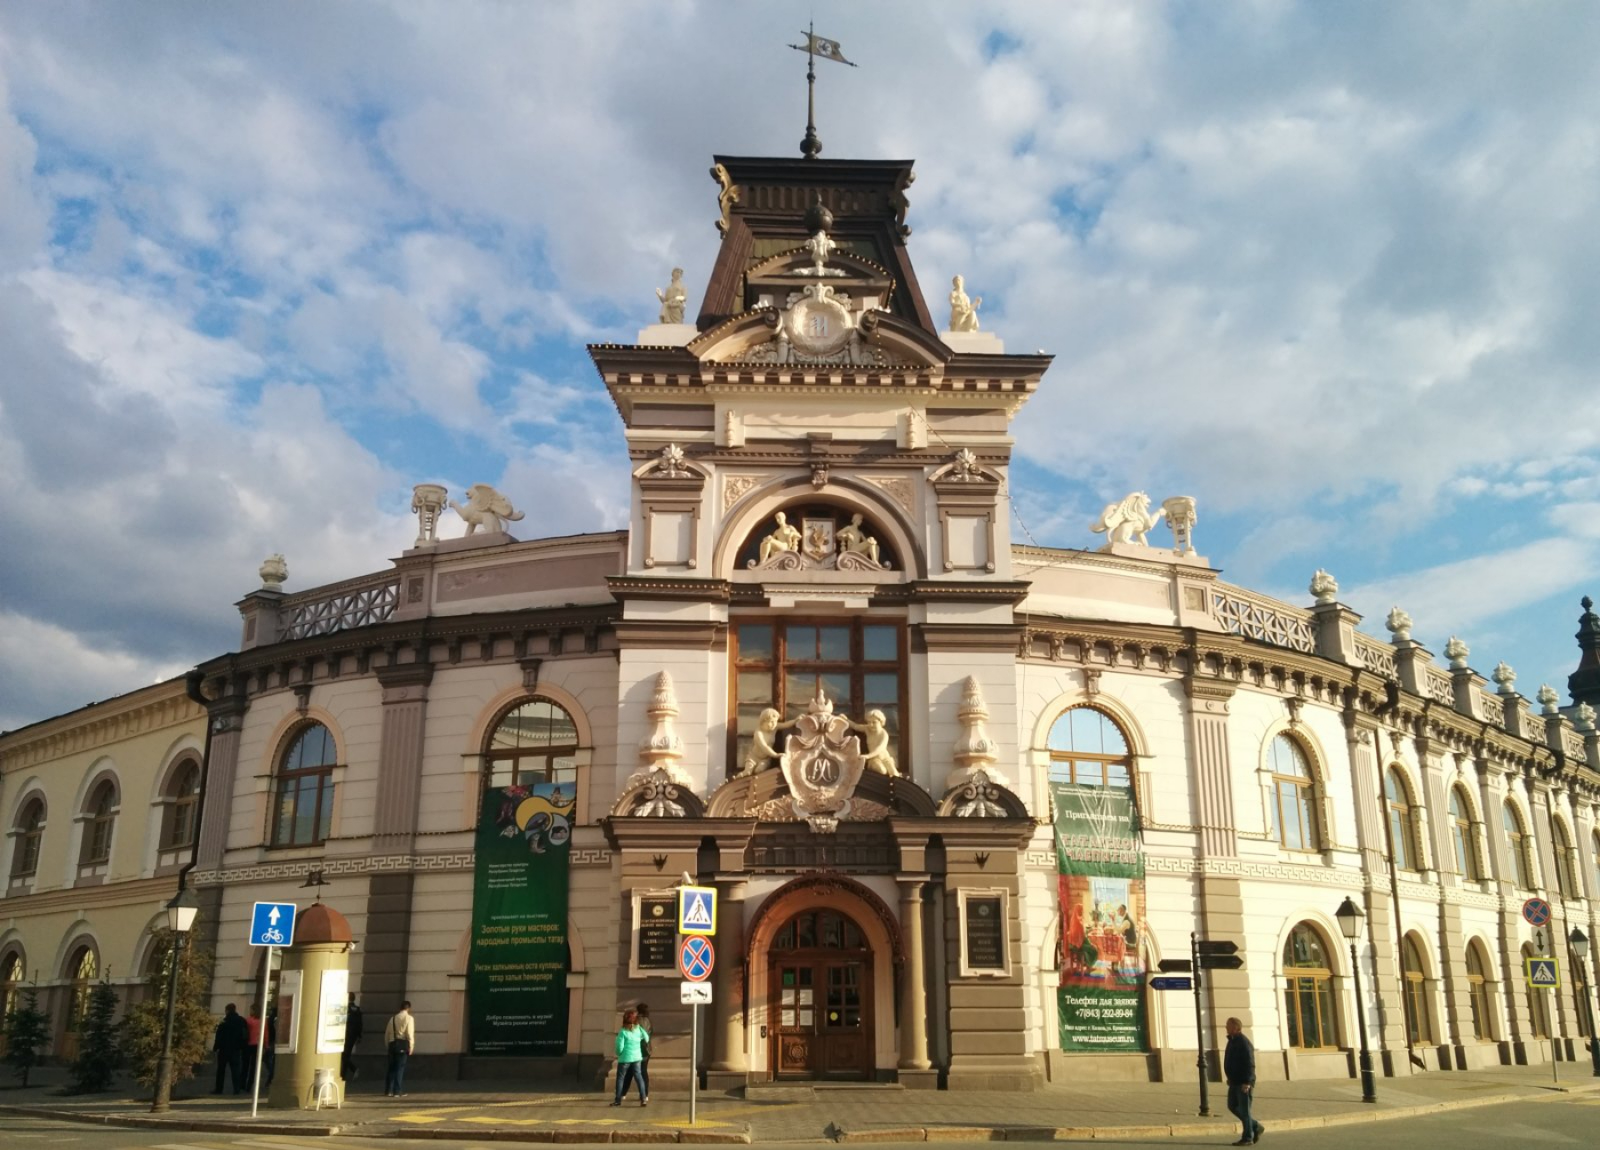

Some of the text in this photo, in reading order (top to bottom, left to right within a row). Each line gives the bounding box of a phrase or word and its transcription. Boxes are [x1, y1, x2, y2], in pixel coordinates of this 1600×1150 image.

[481, 924, 559, 934] Золотые руки мастеров:
[476, 936, 564, 946] народные промыслы татар
[1065, 995, 1097, 1007] Телефон
[1075, 1009, 1133, 1019] +7(843) 292-89-84
